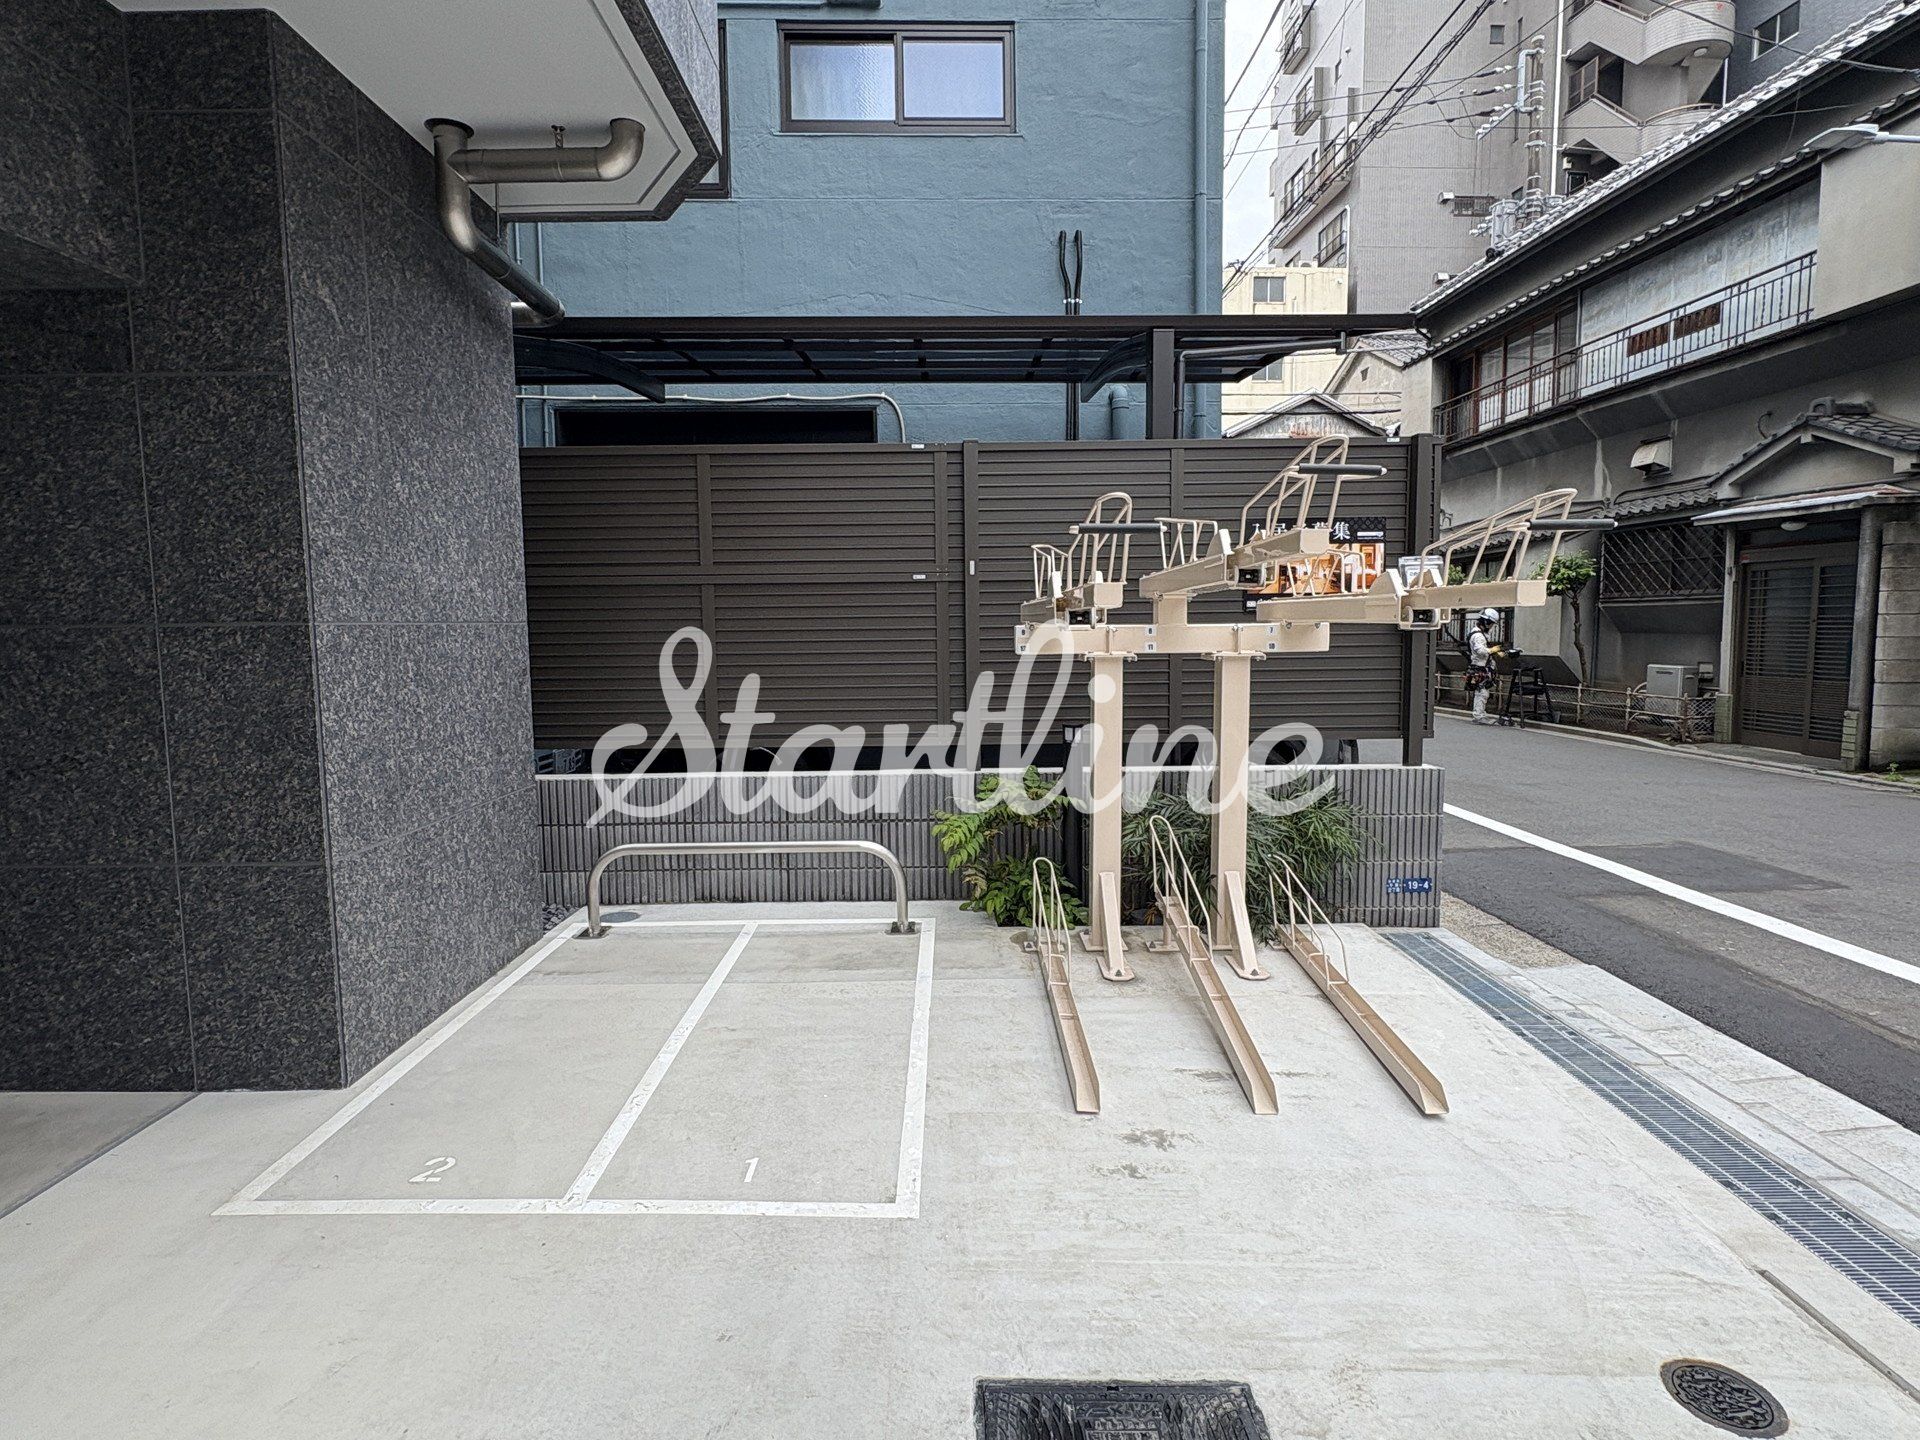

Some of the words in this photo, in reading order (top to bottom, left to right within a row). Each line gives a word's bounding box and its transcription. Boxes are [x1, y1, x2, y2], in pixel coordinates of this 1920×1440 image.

[1408, 880, 1429, 890] 19-4
[409, 1157, 456, 1182] 2
[743, 1157, 760, 1182] 1
